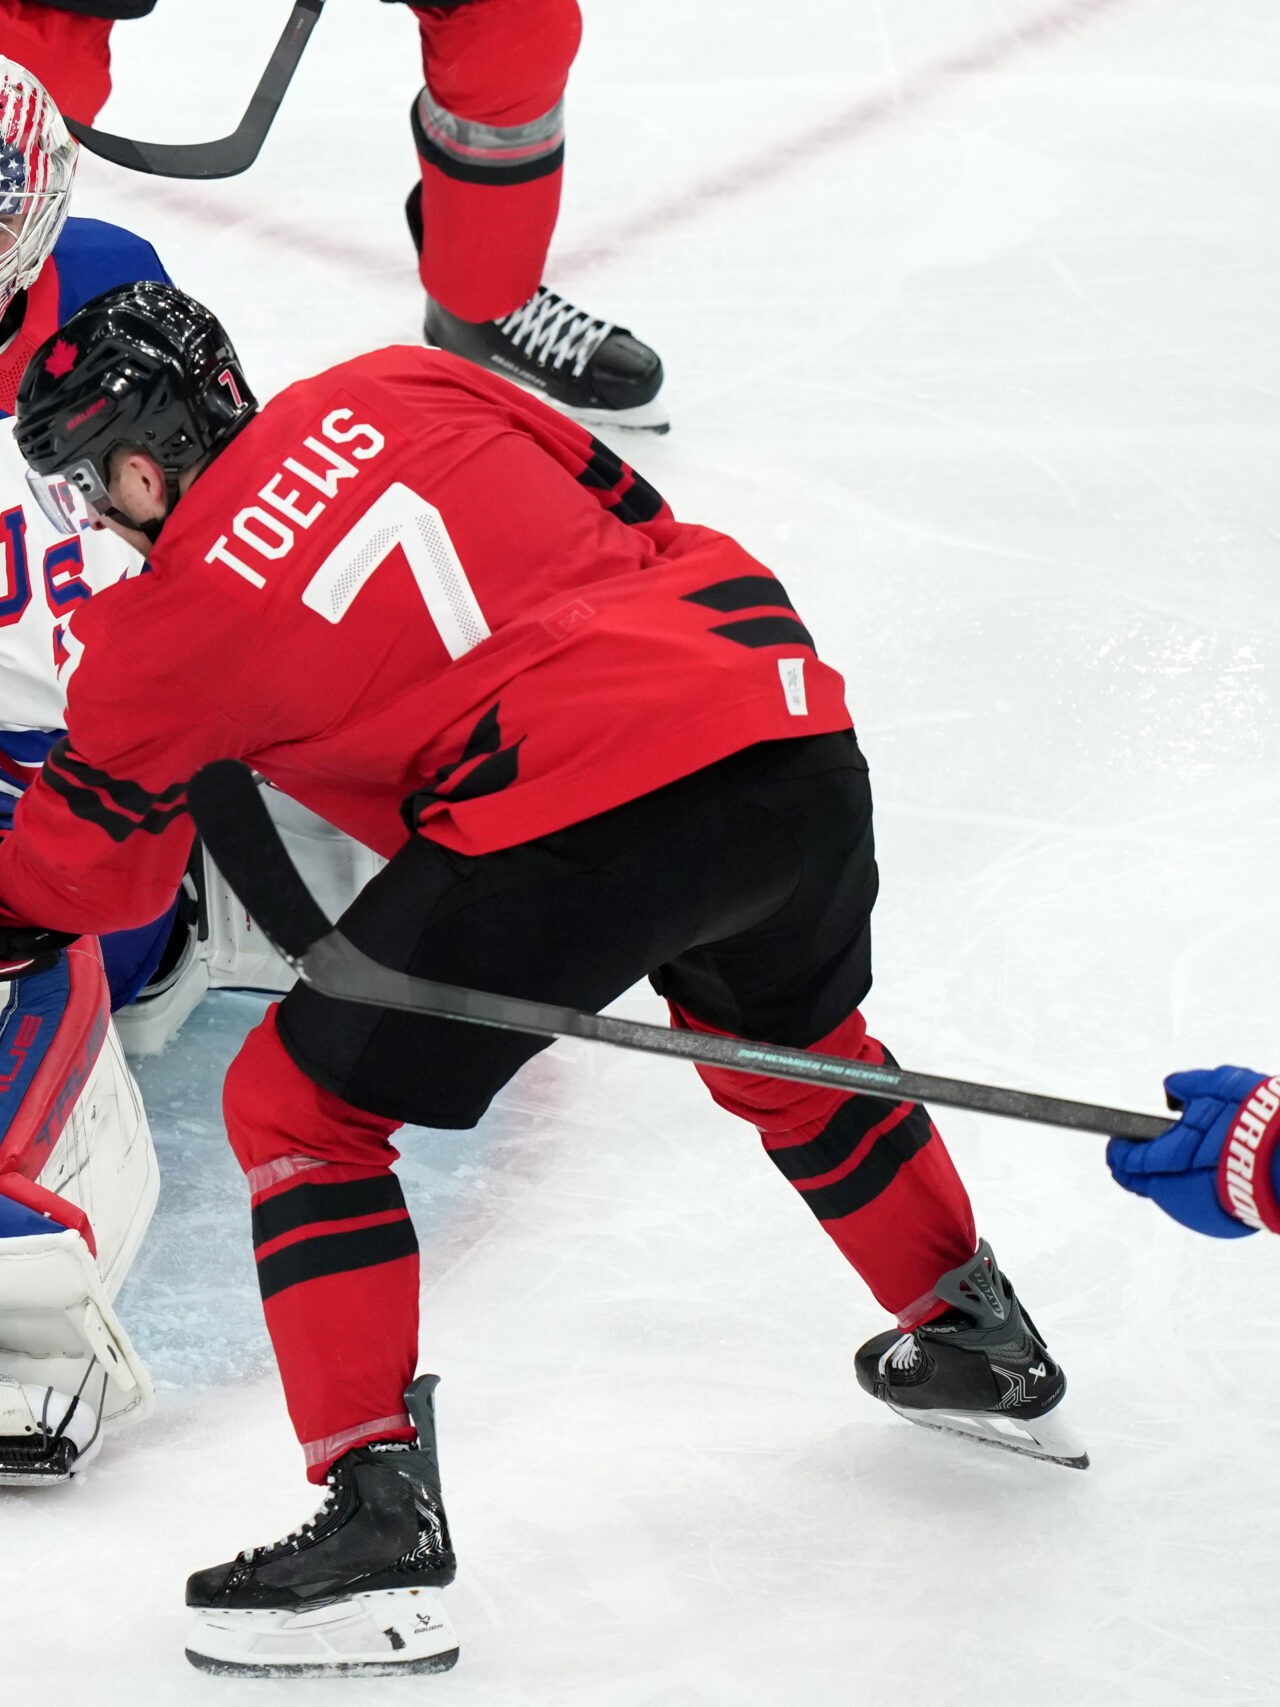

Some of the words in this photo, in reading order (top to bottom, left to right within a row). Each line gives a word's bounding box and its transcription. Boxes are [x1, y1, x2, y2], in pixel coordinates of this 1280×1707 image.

[218, 369, 243, 408] 7
[204, 408, 385, 590] TOEWS
[301, 481, 493, 662] 7
[35, 1007, 107, 1147] TRUE
